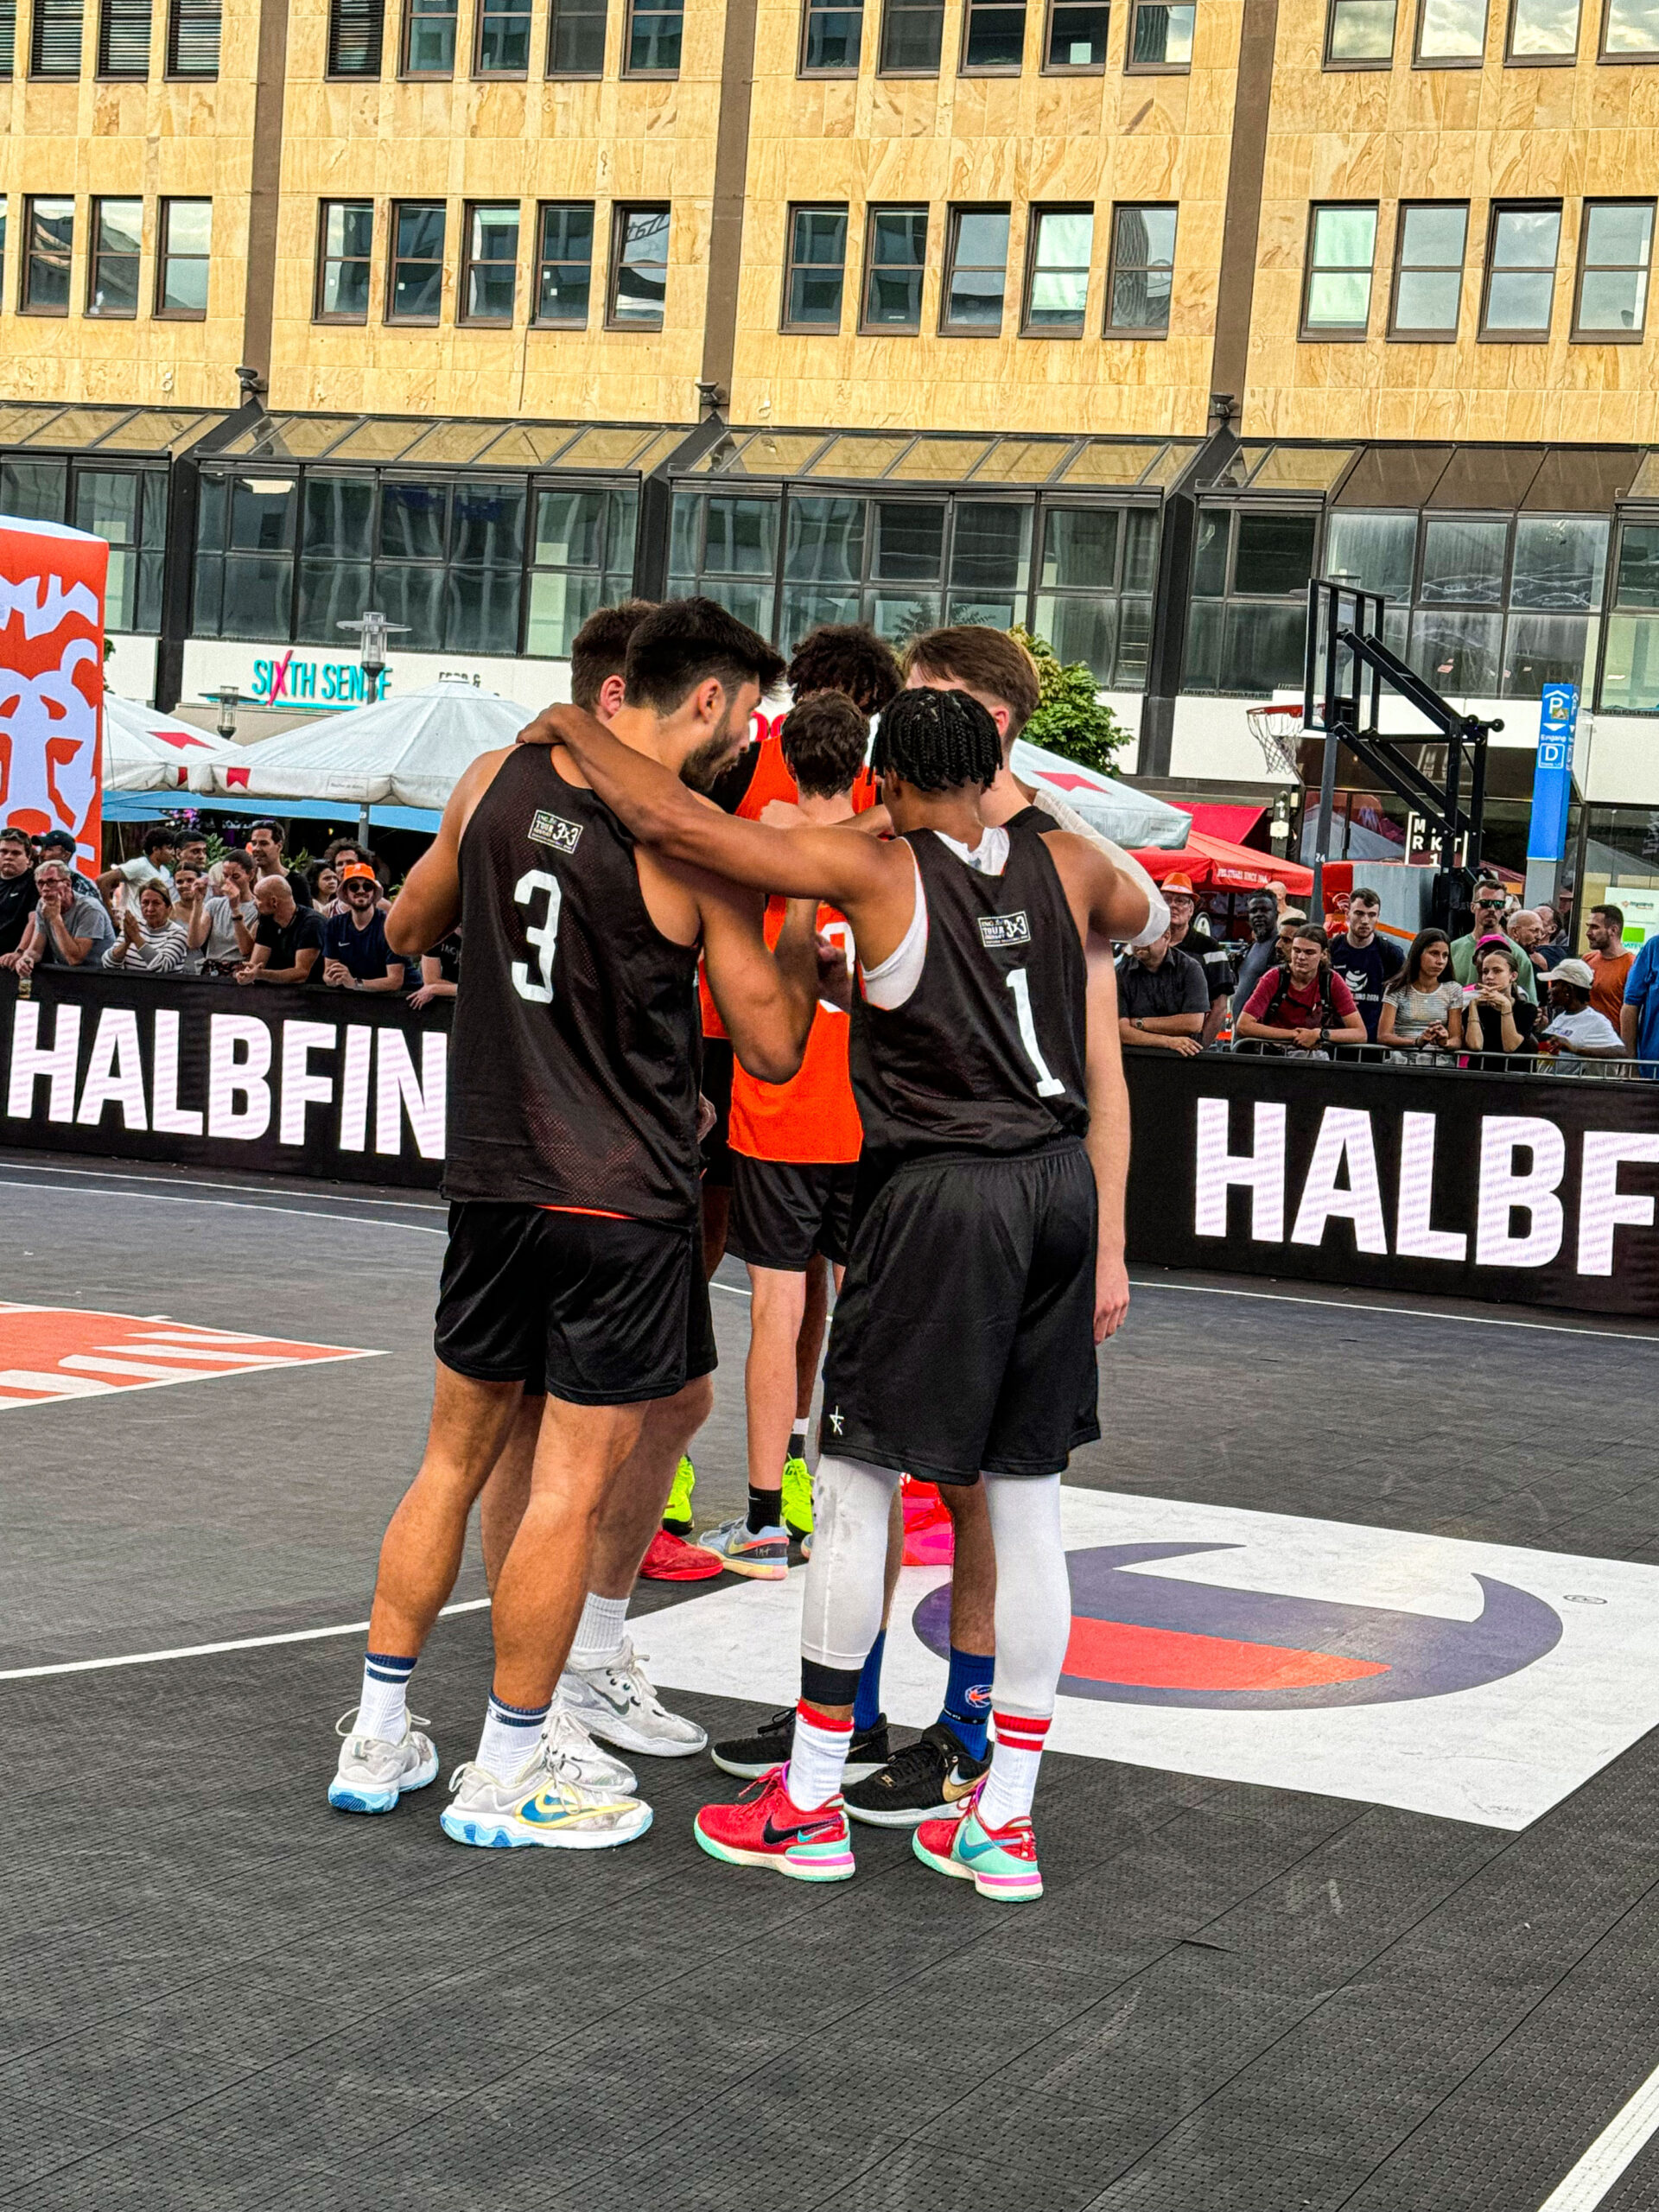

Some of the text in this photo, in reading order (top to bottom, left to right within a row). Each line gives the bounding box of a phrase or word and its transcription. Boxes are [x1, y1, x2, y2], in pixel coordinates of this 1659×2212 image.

[251, 650, 393, 707] SIXTH SENE
[1541, 734, 1567, 743] Eingang
[1544, 746, 1559, 761] D
[511, 869, 562, 1004] 3
[7, 1000, 448, 1160] HALBFIN
[1006, 968, 1065, 1097] 1
[1195, 1097, 1659, 1276] HALBF
